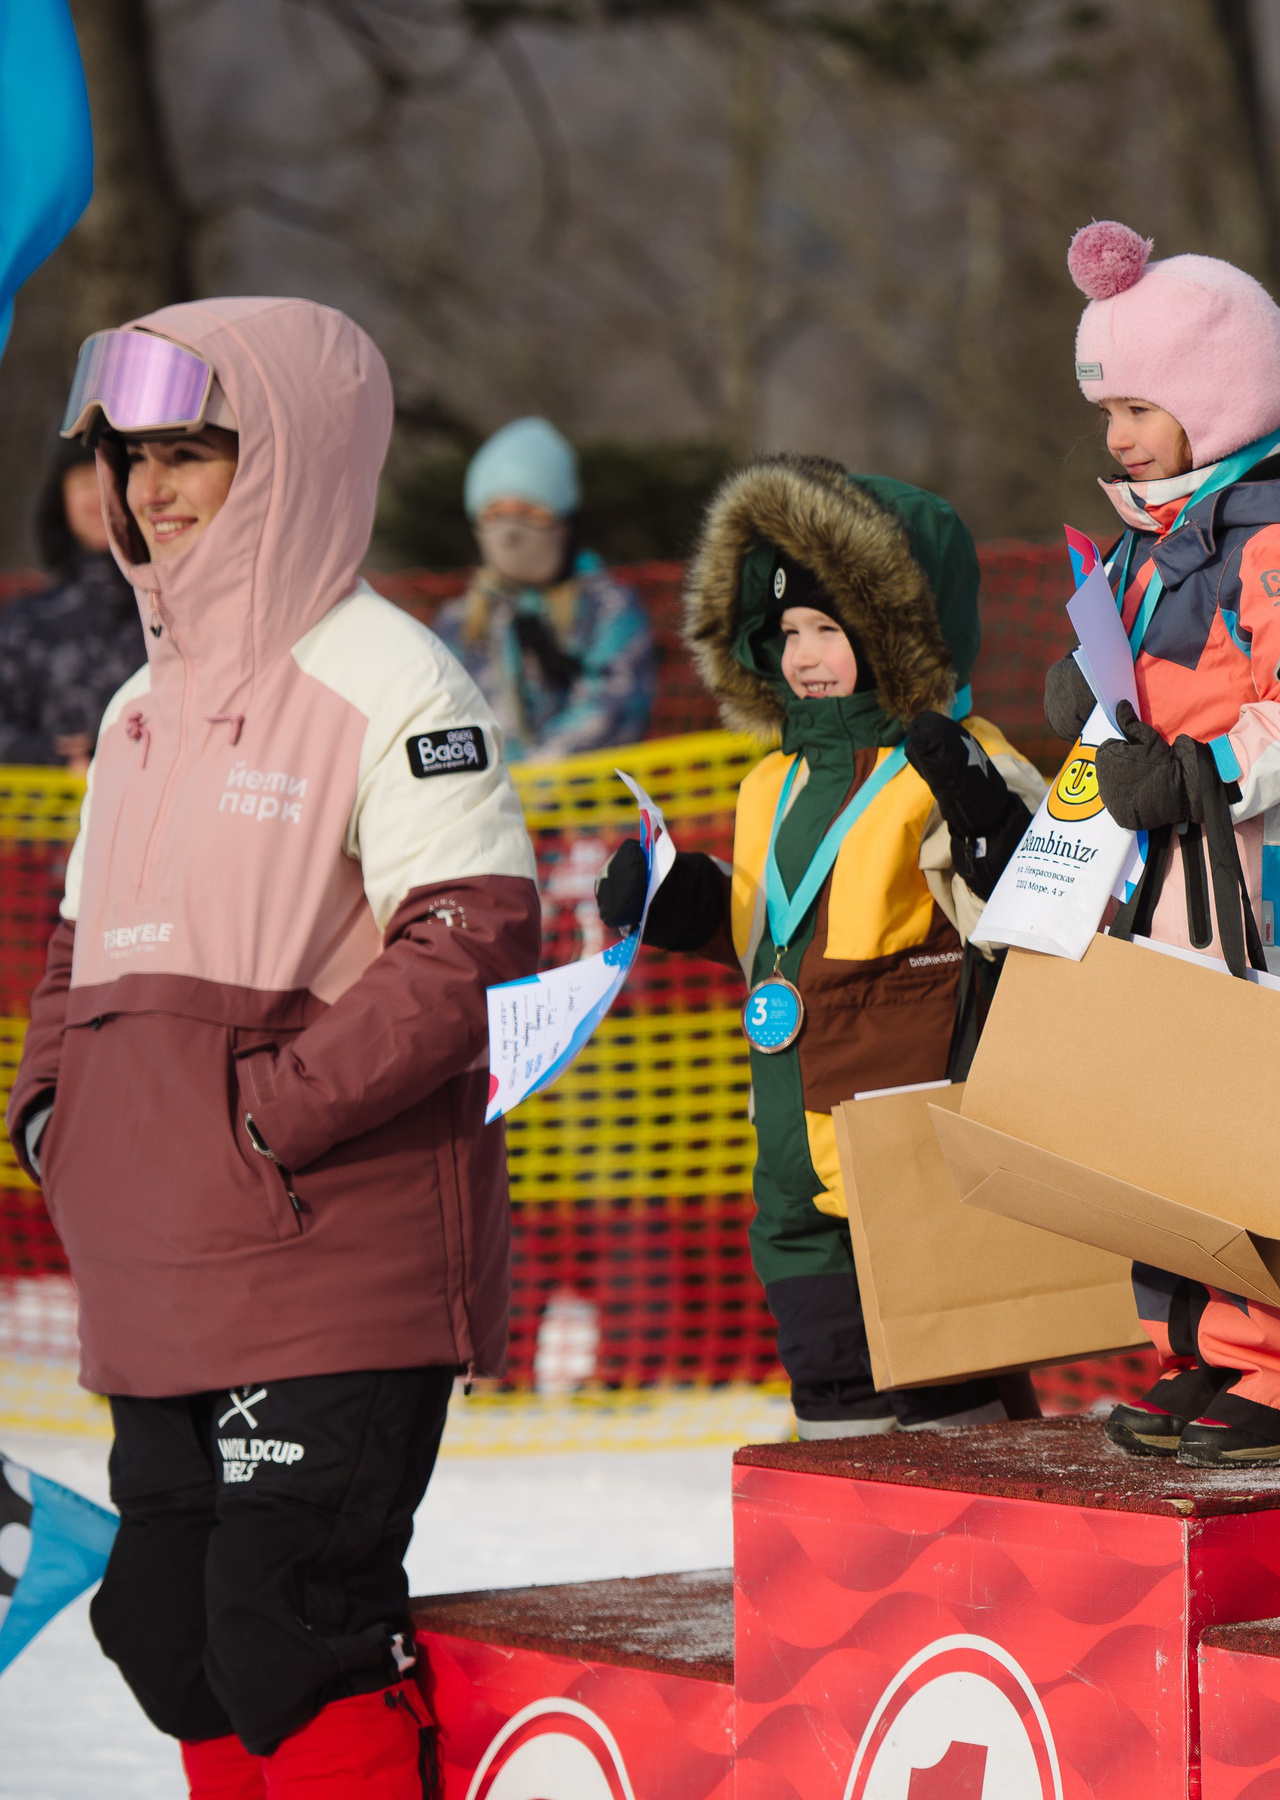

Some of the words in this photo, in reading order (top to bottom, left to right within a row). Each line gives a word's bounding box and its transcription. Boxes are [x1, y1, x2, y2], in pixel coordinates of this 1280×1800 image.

[218, 791, 303, 825] парк
[1051, 887, 1057, 896] 4
[751, 997, 768, 1026] 3
